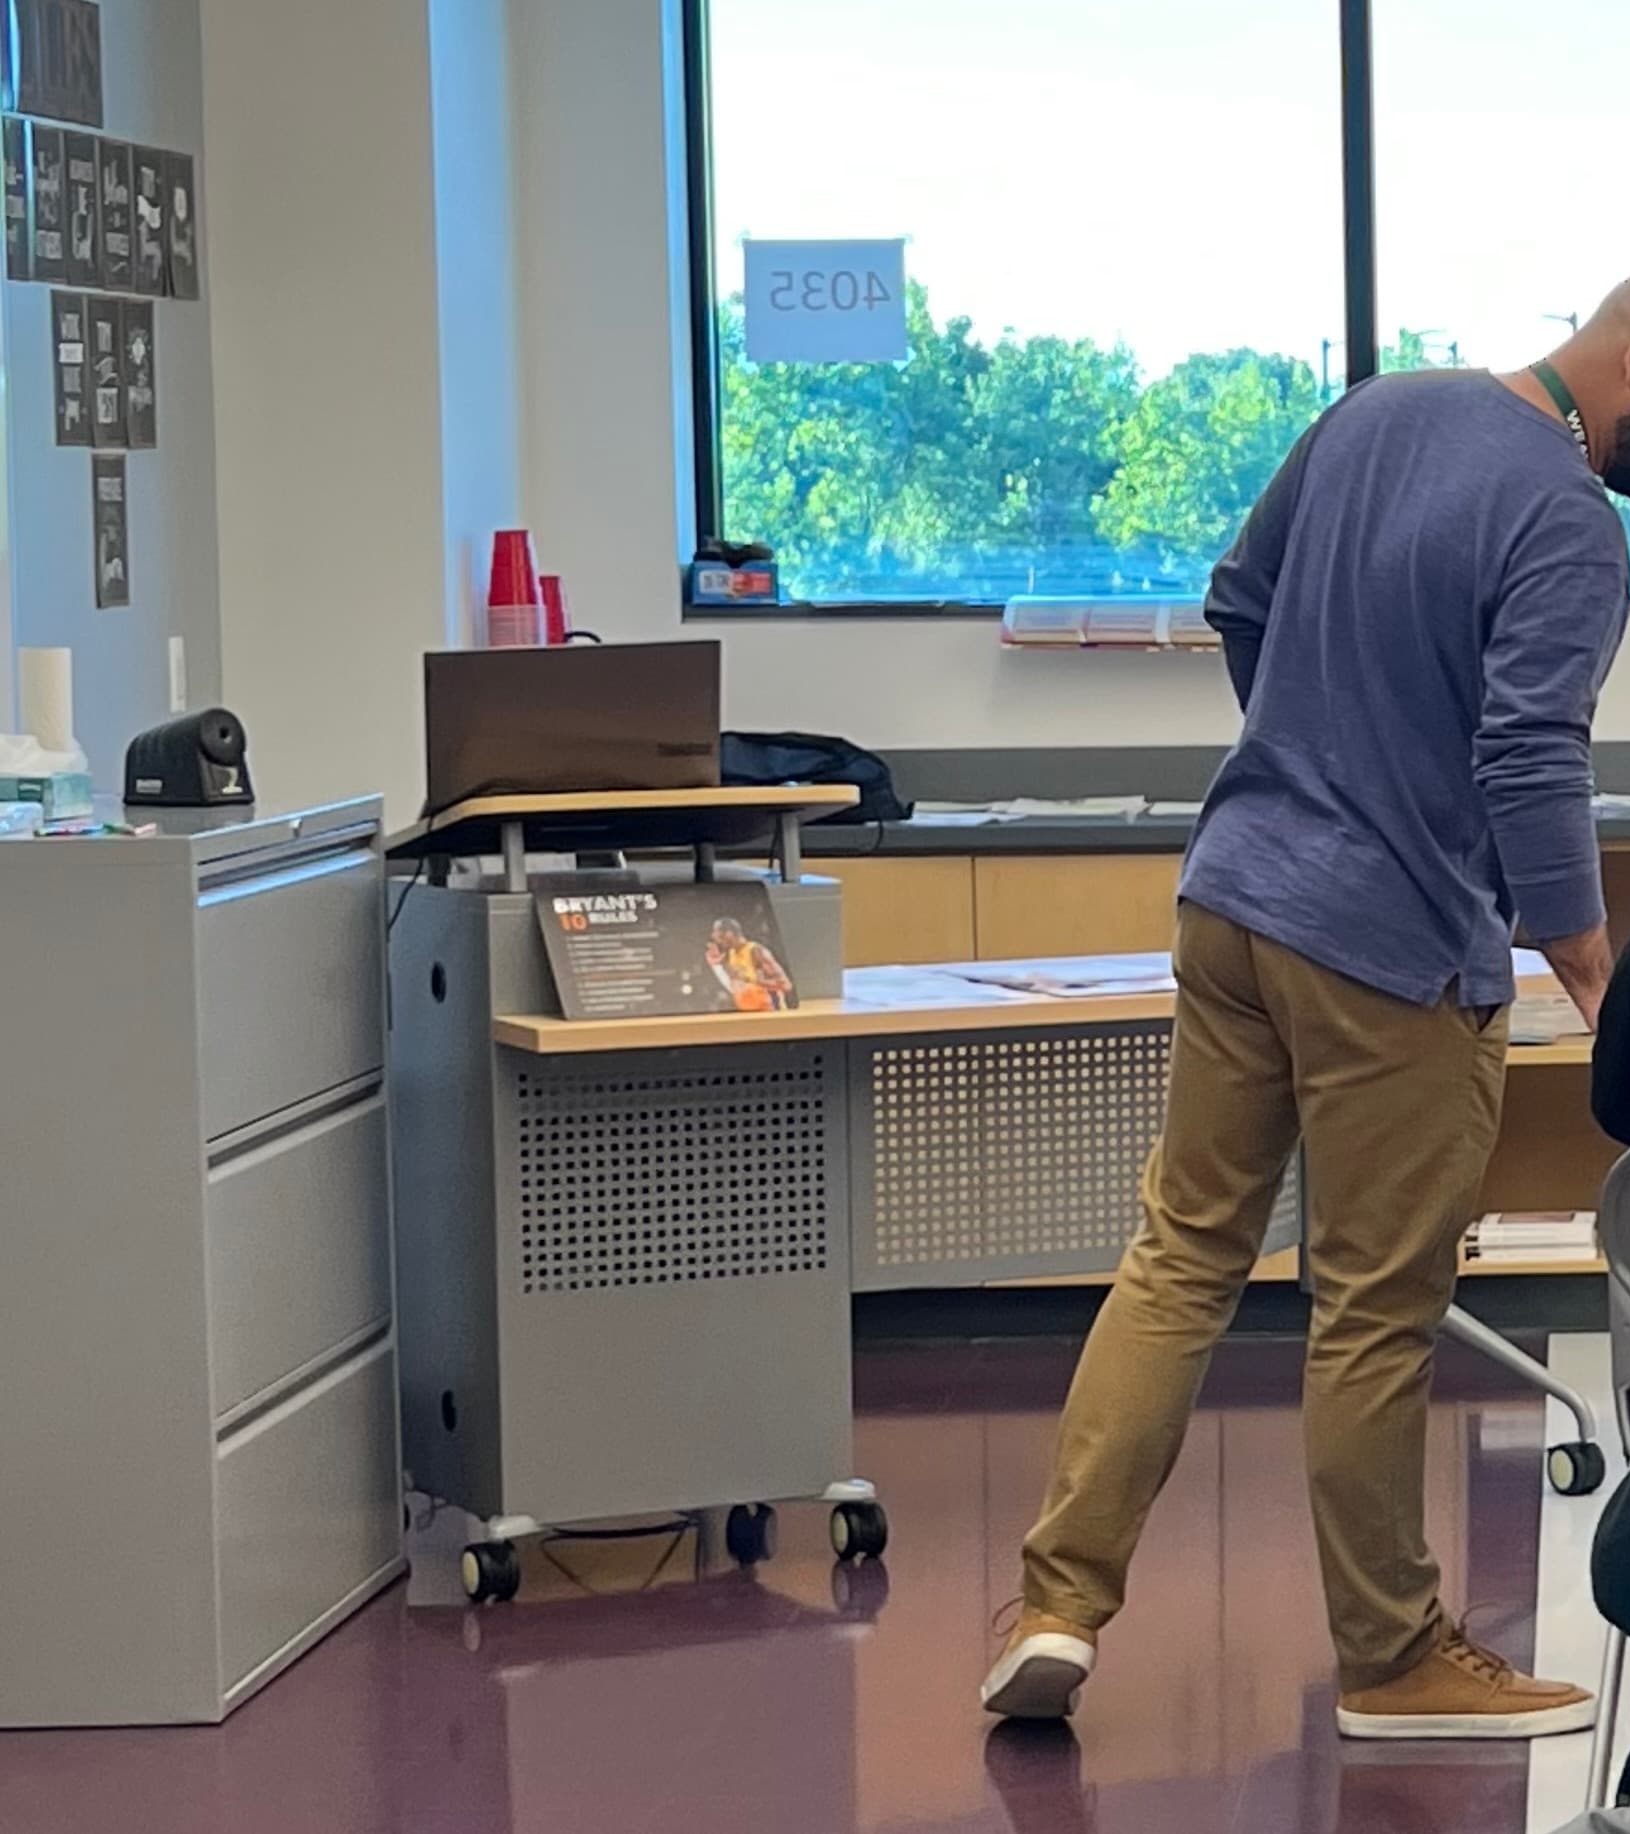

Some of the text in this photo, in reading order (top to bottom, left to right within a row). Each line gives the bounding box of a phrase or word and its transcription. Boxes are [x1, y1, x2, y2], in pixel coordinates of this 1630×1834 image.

[552, 894, 658, 914] BRYANT'S
[560, 911, 638, 931] 10 RULES
